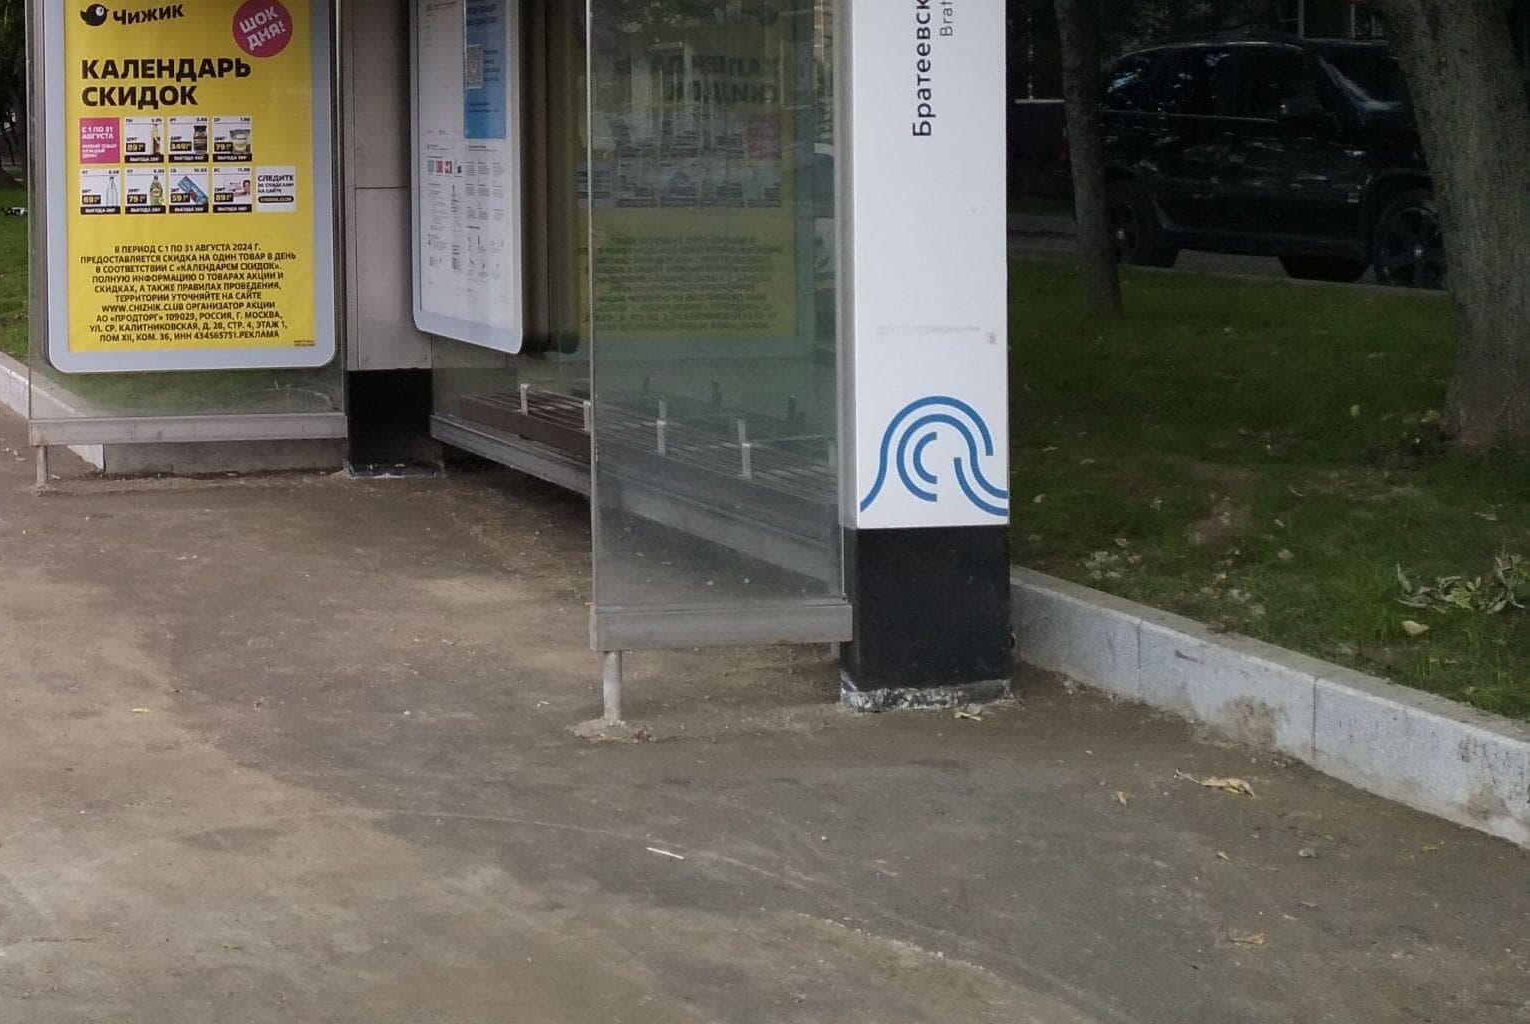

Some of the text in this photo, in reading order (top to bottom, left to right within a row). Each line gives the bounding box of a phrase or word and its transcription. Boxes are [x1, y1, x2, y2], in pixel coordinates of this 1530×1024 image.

[239, 6, 278, 34] ШОК
[247, 21, 286, 50] ДНЯ!
[82, 58, 251, 82] КАЛЕНДАРЬ
[82, 85, 198, 109] СКИДОК
[121, 245, 156, 254] ПЕРИОД
[184, 244, 193, 252] 31
[194, 244, 231, 252] АВГУСТА
[232, 243, 252, 251] 2024
[80, 255, 161, 264] ПРЕДОСТАВЛЯЕТСЯ
[163, 254, 197, 263] СКИДКА
[212, 253, 237, 262] ОДИН
[274, 252, 296, 260] ДЕНЬ
[103, 265, 167, 273] СООТВЕТСТВИИ
[169, 264, 174, 272] С
[92, 275, 130, 283] ПОЛНУЮ
[132, 274, 196, 282] ИНФОРМАЦИЮ
[198, 273, 204, 281] О
[206, 273, 245, 281] ТОВАРАХ
[246, 272, 276, 280] АКЦИИ
[94, 285, 138, 293] СКИДКАХ,
[147, 284, 175, 292] ТАКЖЕ
[177, 283, 222, 291] ПРАВИЛАХ
[115, 290, 262, 302] ТЕРРИТОРИИ УТОЧНЯЙТЕ НА САЙТЕ
[101, 301, 275, 312] WWW.CHIZHIK.CLUB ОРГАНИЗАТОР АКЦИИ
[110, 314, 163, 323] «ПРОДТОРГ»
[199, 312, 235, 320] РОССИЯ,
[244, 311, 283, 319] МОСКВА,
[119, 322, 201, 332] КАЛИТНИКОВСКАЯ,
[202, 322, 210, 330] Д.
[100, 334, 120, 342] ПОМ
[136, 333, 158, 341] КОМ.
